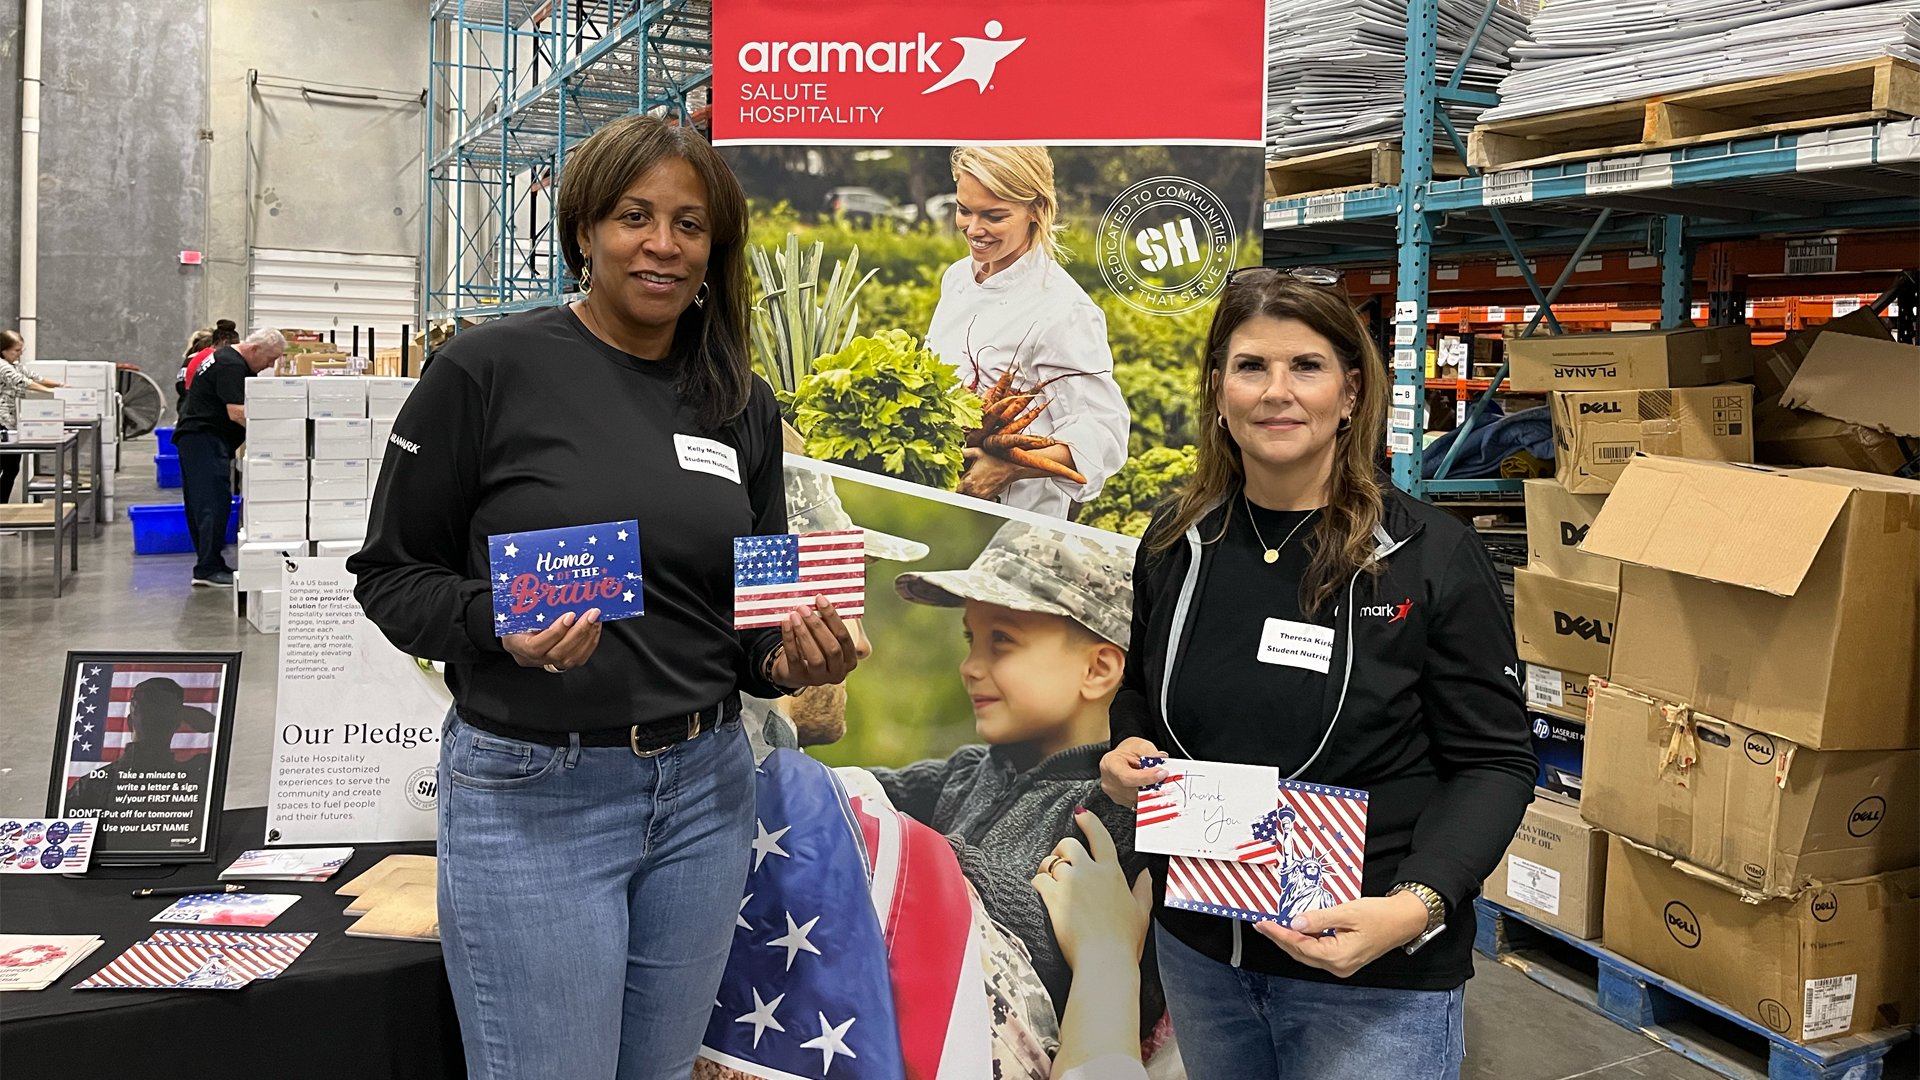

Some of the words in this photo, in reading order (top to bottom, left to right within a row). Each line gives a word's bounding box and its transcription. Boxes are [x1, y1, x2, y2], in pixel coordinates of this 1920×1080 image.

[738, 32, 943, 73] aramark
[740, 83, 827, 101] SALUTE
[740, 106, 884, 123] HOSPITALITY
[1106, 204, 1132, 285] DEDICATED
[1131, 190, 1151, 205] TO
[1156, 186, 1227, 253] COMMUNITIES
[1135, 217, 1200, 272] SH
[1138, 288, 1175, 306] THAT
[1181, 266, 1222, 303] SERVE
[1554, 367, 1616, 377] PLANAR
[1579, 402, 1621, 414] DELL
[684, 456, 711, 464] Student
[1560, 521, 1590, 545] DE
[536, 552, 595, 572] Home
[557, 571, 571, 580] OF
[572, 567, 599, 578] THE
[511, 573, 623, 614] Brave
[1280, 632, 1312, 643] Theresa
[1267, 645, 1298, 656] Student
[1300, 650, 1332, 662] Nutriti
[1564, 682, 1589, 694] PLA
[1535, 718, 1548, 738] hp
[1552, 726, 1579, 739] LASERJET
[282, 724, 334, 745] Our
[343, 723, 439, 749] Pledge.
[1747, 741, 1771, 756] DELL
[280, 755, 309, 763] Salute
[312, 754, 365, 763] Hospitality
[90, 770, 108, 779] DO:
[119, 771, 137, 779] Take
[145, 771, 176, 779] minute
[279, 767, 325, 775] generates
[327, 765, 380, 774] customized
[117, 783, 139, 791] write
[147, 783, 171, 791] letter
[172, 783, 179, 791] &
[181, 783, 198, 792] sign
[278, 778, 333, 787] experiences
[417, 781, 437, 797] SH
[1173, 770, 1225, 808] Thank
[115, 794, 146, 804] w/your
[277, 790, 329, 798] community
[277, 802, 308, 810] spaces
[323, 800, 341, 808] fuel
[344, 800, 376, 809] people
[104, 810, 118, 818] Put
[120, 810, 132, 818] off
[134, 810, 146, 818] for
[148, 810, 193, 818] tomorrow!
[320, 812, 355, 820] futures.
[1852, 810, 1880, 823] DELL
[120, 825, 140, 833] your
[162, 823, 189, 831] NAME
[1203, 806, 1241, 843] You
[27, 831, 41, 839] USA
[1532, 826, 1561, 842] VIRGIN
[1538, 839, 1553, 850] OIL
[21, 855, 35, 863] USA
[1815, 901, 1835, 911] DELL
[1668, 914, 1697, 937] DELL
